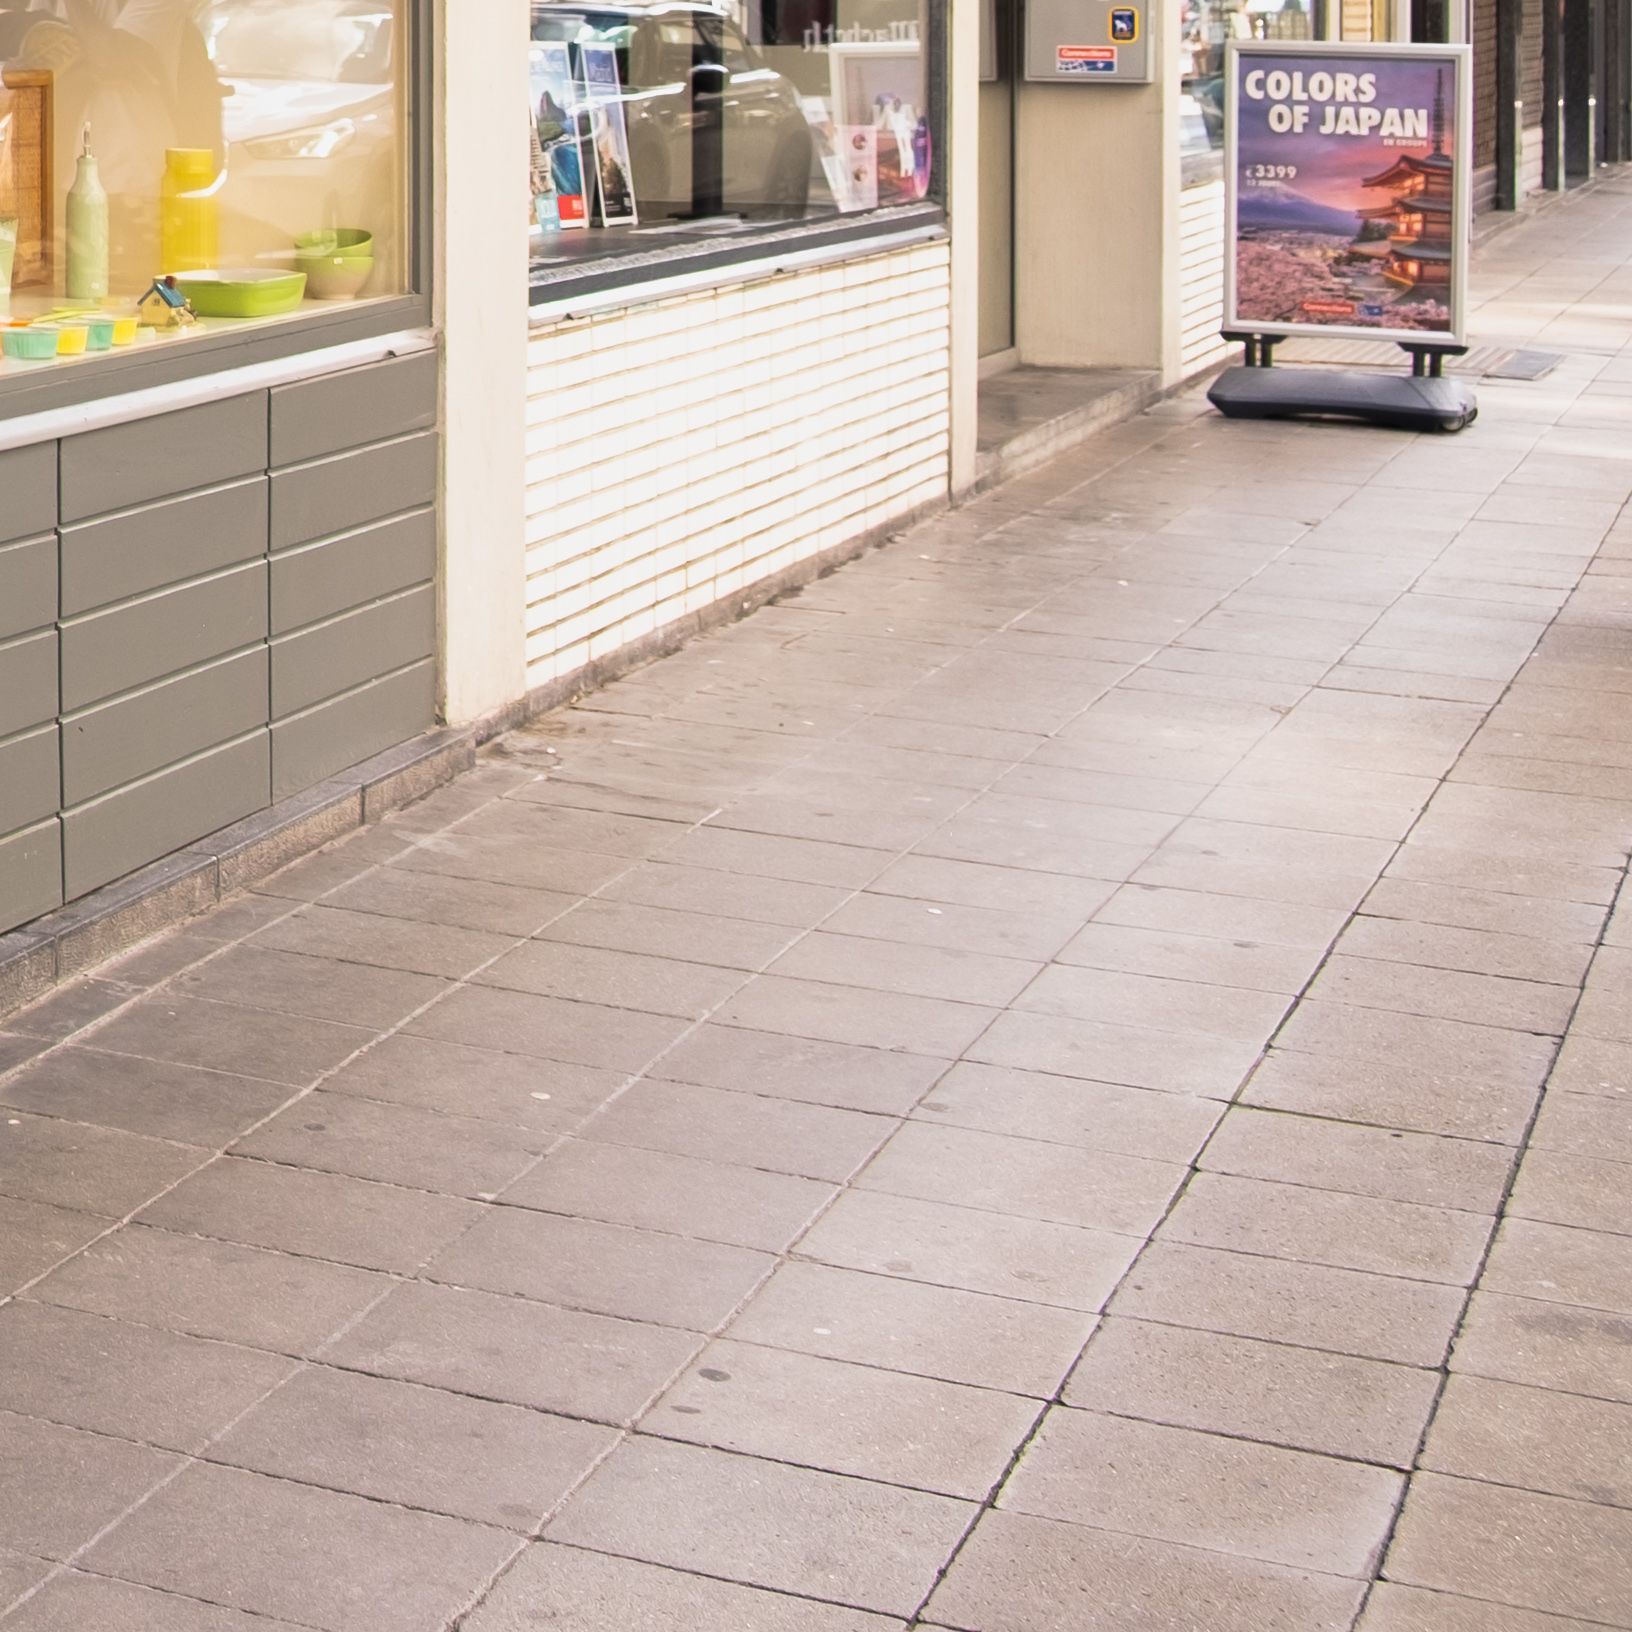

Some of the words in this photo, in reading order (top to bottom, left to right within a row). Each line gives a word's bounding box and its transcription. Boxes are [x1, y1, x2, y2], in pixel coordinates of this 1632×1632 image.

[1245, 69, 1377, 103] COLORS
[1268, 104, 1309, 134] OF
[1319, 105, 1428, 138] JAPAN
[1255, 164, 1297, 179] 3399
